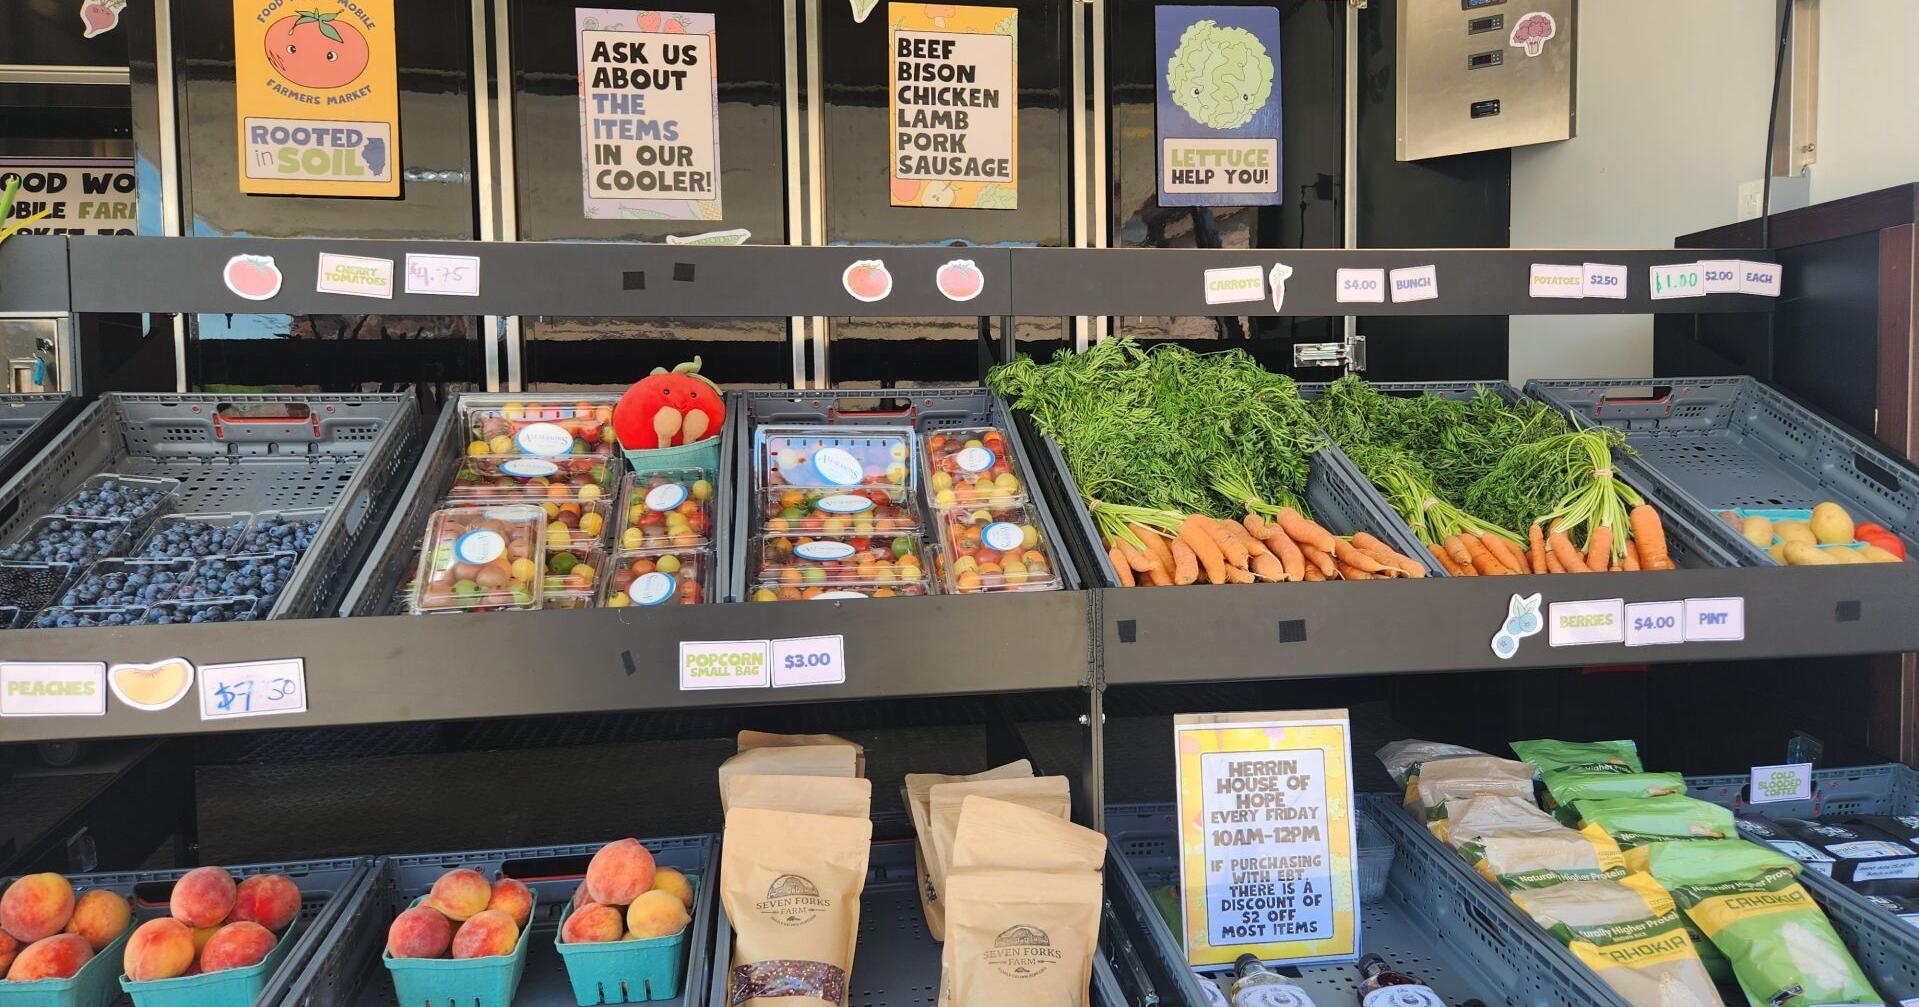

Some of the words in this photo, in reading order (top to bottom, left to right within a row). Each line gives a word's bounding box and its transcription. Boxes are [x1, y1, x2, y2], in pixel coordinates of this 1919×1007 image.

[591, 41, 648, 65] ASK
[663, 44, 698, 66] US
[897, 37, 955, 60] BEEF
[592, 67, 687, 91] ABOUT
[897, 61, 976, 83] BISON
[266, 79, 321, 105] FARMERS
[327, 84, 372, 105] MARKET
[897, 85, 999, 108] CHICKEN
[592, 93, 646, 115] THE
[898, 109, 969, 130] LAMB
[251, 125, 363, 148] ROOTED
[593, 119, 679, 141] ITEMS
[898, 132, 967, 153] PORK
[255, 149, 273, 167] in
[277, 147, 364, 176] SOIL
[595, 144, 621, 166] IN
[636, 145, 693, 167] OUR
[1171, 148, 1270, 168] LETTUCE
[898, 155, 1010, 177] SAUSAGE
[596, 170, 711, 193] COOLER!
[1171, 169, 1215, 185] HELP
[1224, 169, 1269, 185] YOU!
[7, 201, 66, 219] BILE
[325, 272, 387, 286] TOMATOES
[335, 264, 378, 276] CHERRY
[1746, 272, 1773, 284] EACH
[1209, 278, 1260, 291] CARROTS
[1344, 280, 1377, 291] $4.00
[1396, 277, 1431, 290] BUNCH
[1534, 275, 1580, 286] POTATOES
[1560, 613, 1613, 628] BERRIES
[1634, 616, 1675, 631] $4.00
[1699, 612, 1728, 625] PINT
[686, 652, 764, 667] POPCORN
[784, 652, 831, 670] $3.00
[689, 667, 730, 678] SMALL
[735, 666, 760, 677] BAG
[8, 680, 95, 696] PEACHES
[1228, 759, 1298, 778] HERRIN
[1216, 775, 1279, 794] HOUSE
[1286, 774, 1311, 791] OF
[1236, 792, 1286, 810] HOPE
[1211, 809, 1259, 824] EVERY
[1265, 806, 1319, 822] FRIDAY
[1212, 825, 1321, 847] 10AM-12PM
[1211, 859, 1223, 872] IF
[1231, 854, 1322, 871] PURCHASING
[1232, 869, 1270, 885] WITH
[1590, 868, 1626, 881] Protein
[1229, 883, 1275, 898] THERE
[1282, 882, 1295, 895] IS
[1303, 881, 1313, 894] A
[756, 898, 791, 910] SEVEN
[795, 896, 831, 907] FORKS
[1221, 896, 1295, 911] DISCOUNT
[1302, 894, 1322, 907] OF
[1724, 890, 1805, 909] CAHOKIA
[780, 907, 807, 915] FARM
[1242, 911, 1260, 924] $2
[1267, 909, 1297, 922] OFF
[1221, 925, 1266, 939] MOST
[1273, 921, 1318, 936] ITEMS
[1611, 922, 1646, 935] Higher
[983, 948, 1020, 960] SEVEN
[1024, 947, 1061, 959] FORKS
[1599, 936, 1687, 961] AHOKIA
[1008, 958, 1036, 966] FARM
